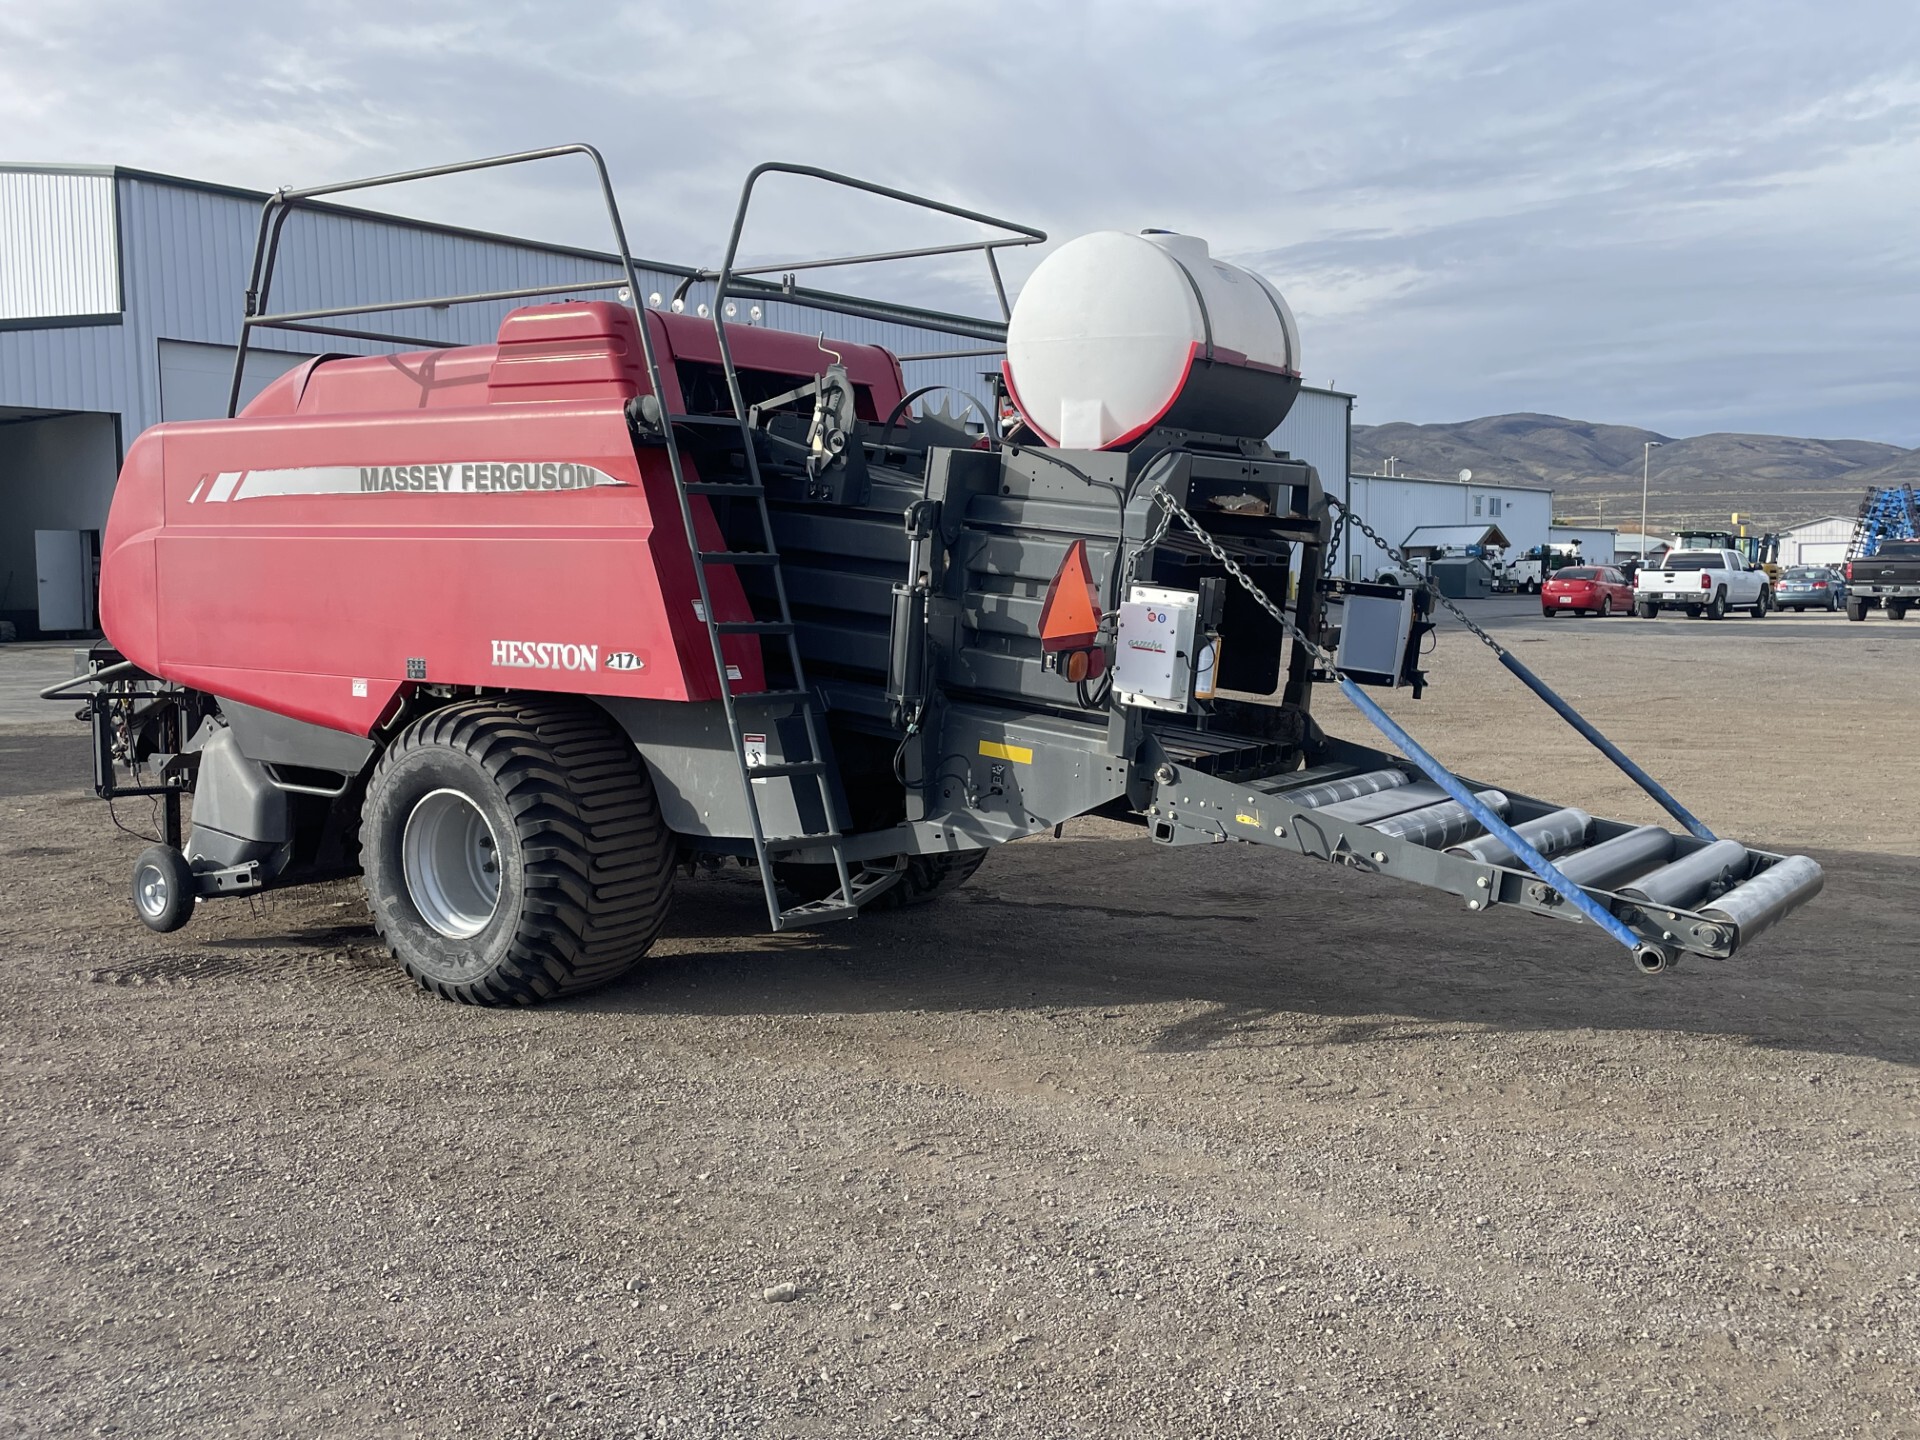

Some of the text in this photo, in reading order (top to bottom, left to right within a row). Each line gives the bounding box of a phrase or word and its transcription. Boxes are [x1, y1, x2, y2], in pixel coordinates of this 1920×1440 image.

[360, 463, 596, 492] MASSEY FERGUSON
[491, 640, 598, 672] HESSTON
